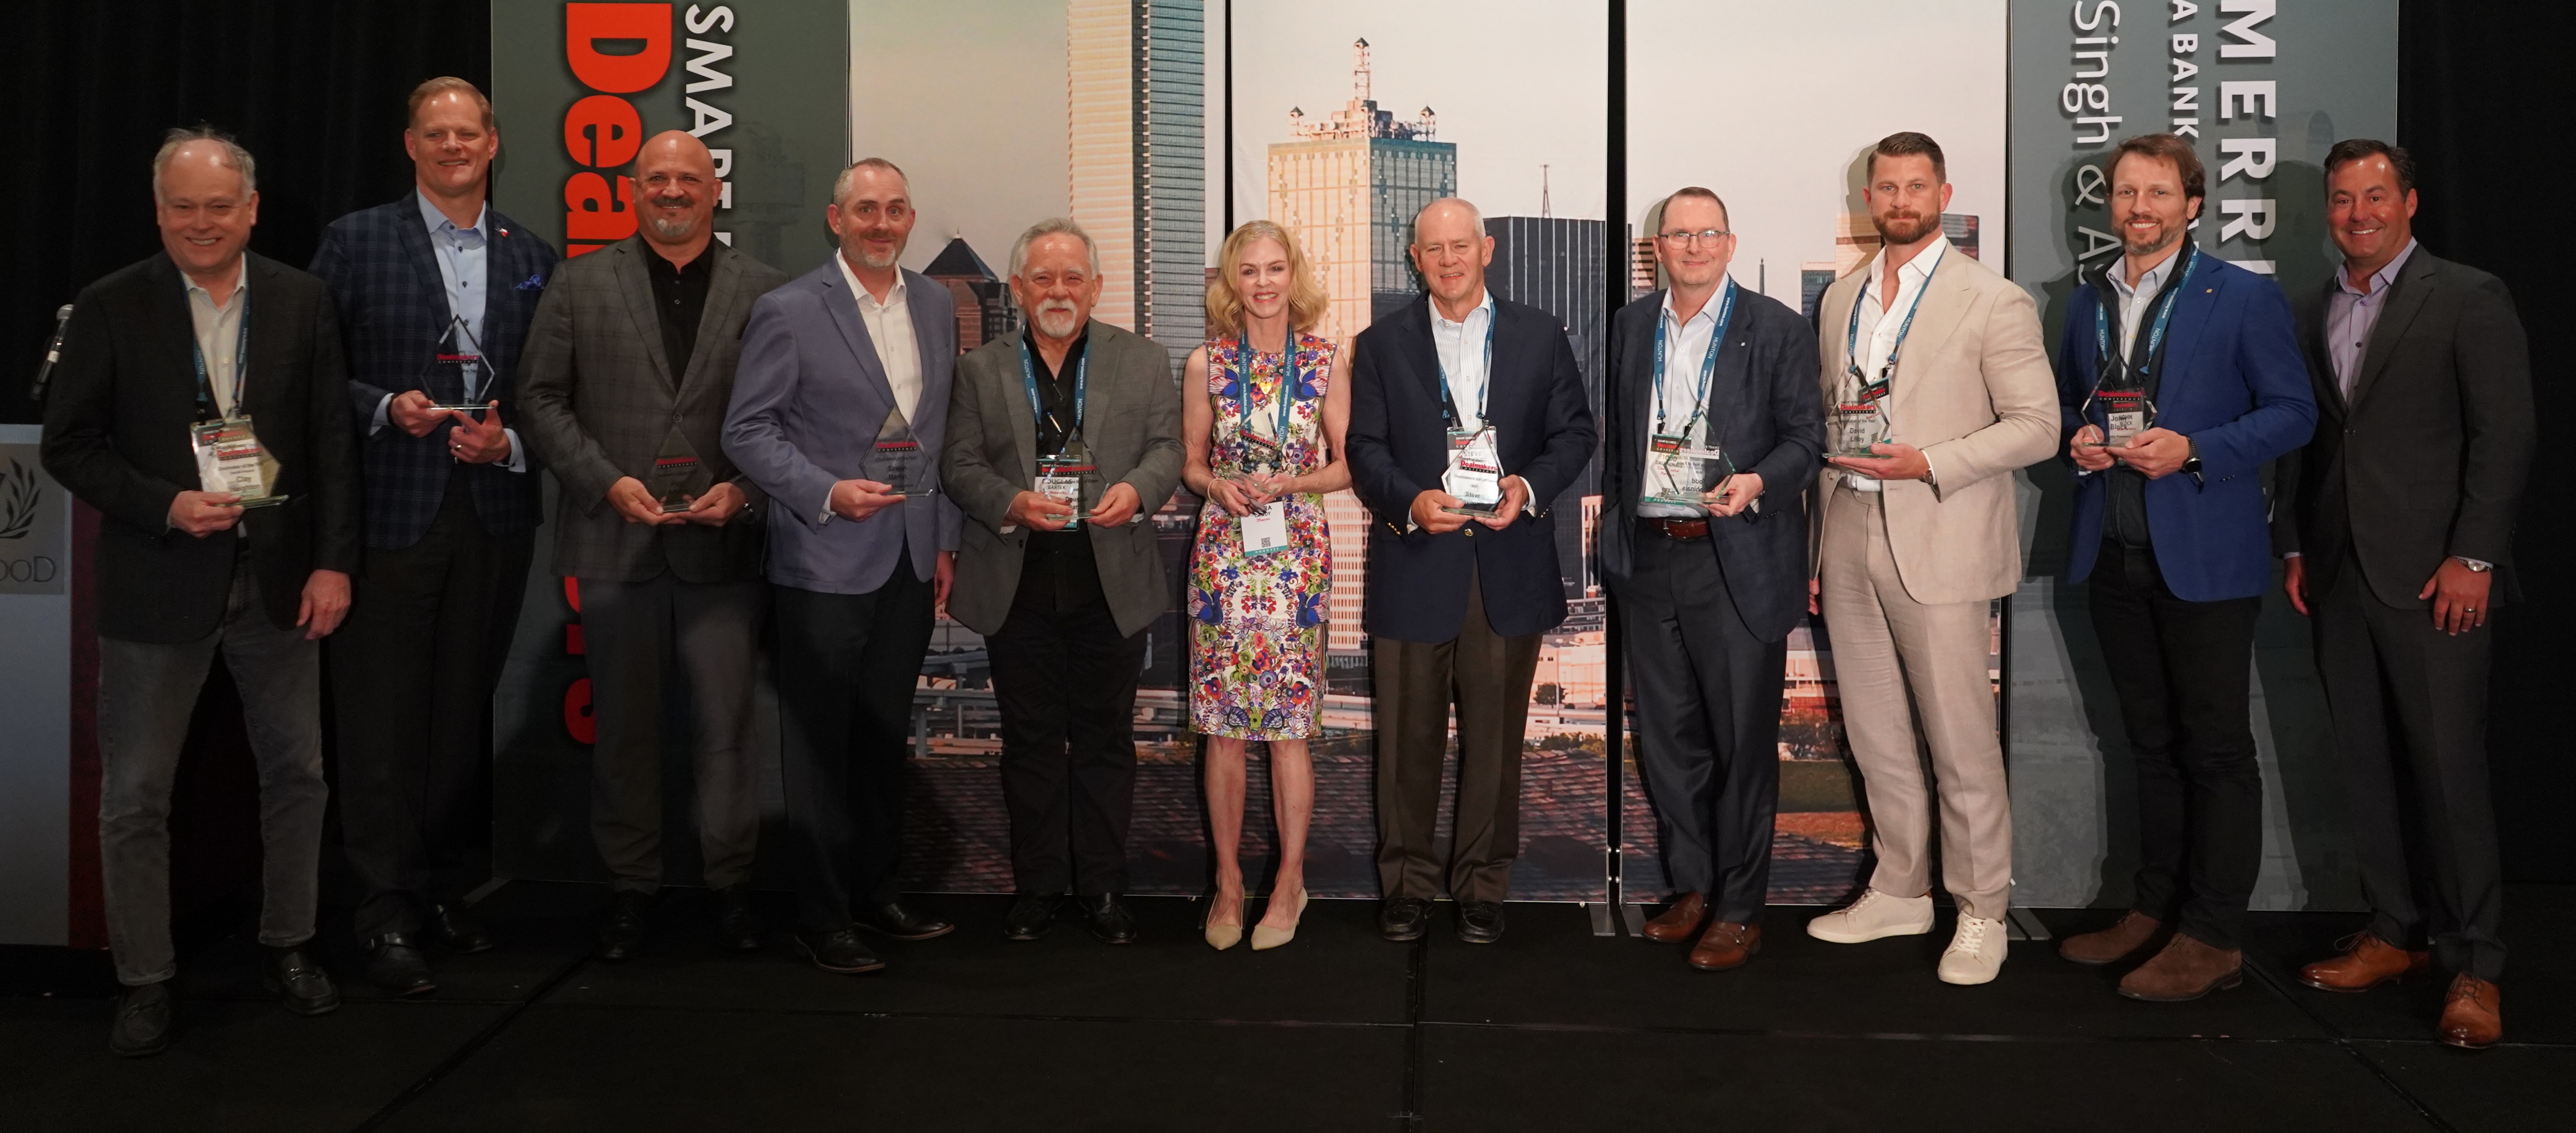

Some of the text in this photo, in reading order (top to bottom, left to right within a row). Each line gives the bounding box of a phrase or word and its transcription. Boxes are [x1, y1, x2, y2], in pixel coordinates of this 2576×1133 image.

[2063, 0, 2123, 143] Singh
[2172, 33, 2199, 138] BANK
[1719, 297, 1730, 327] www.hunton.com
[1898, 317, 1912, 337] HUNTON
[1708, 337, 1719, 359] HUNTON
[2149, 327, 2161, 351] HUNTON
[1241, 429, 1277, 447] Dealmakers
[1461, 460, 1498, 470] Dealmakers
